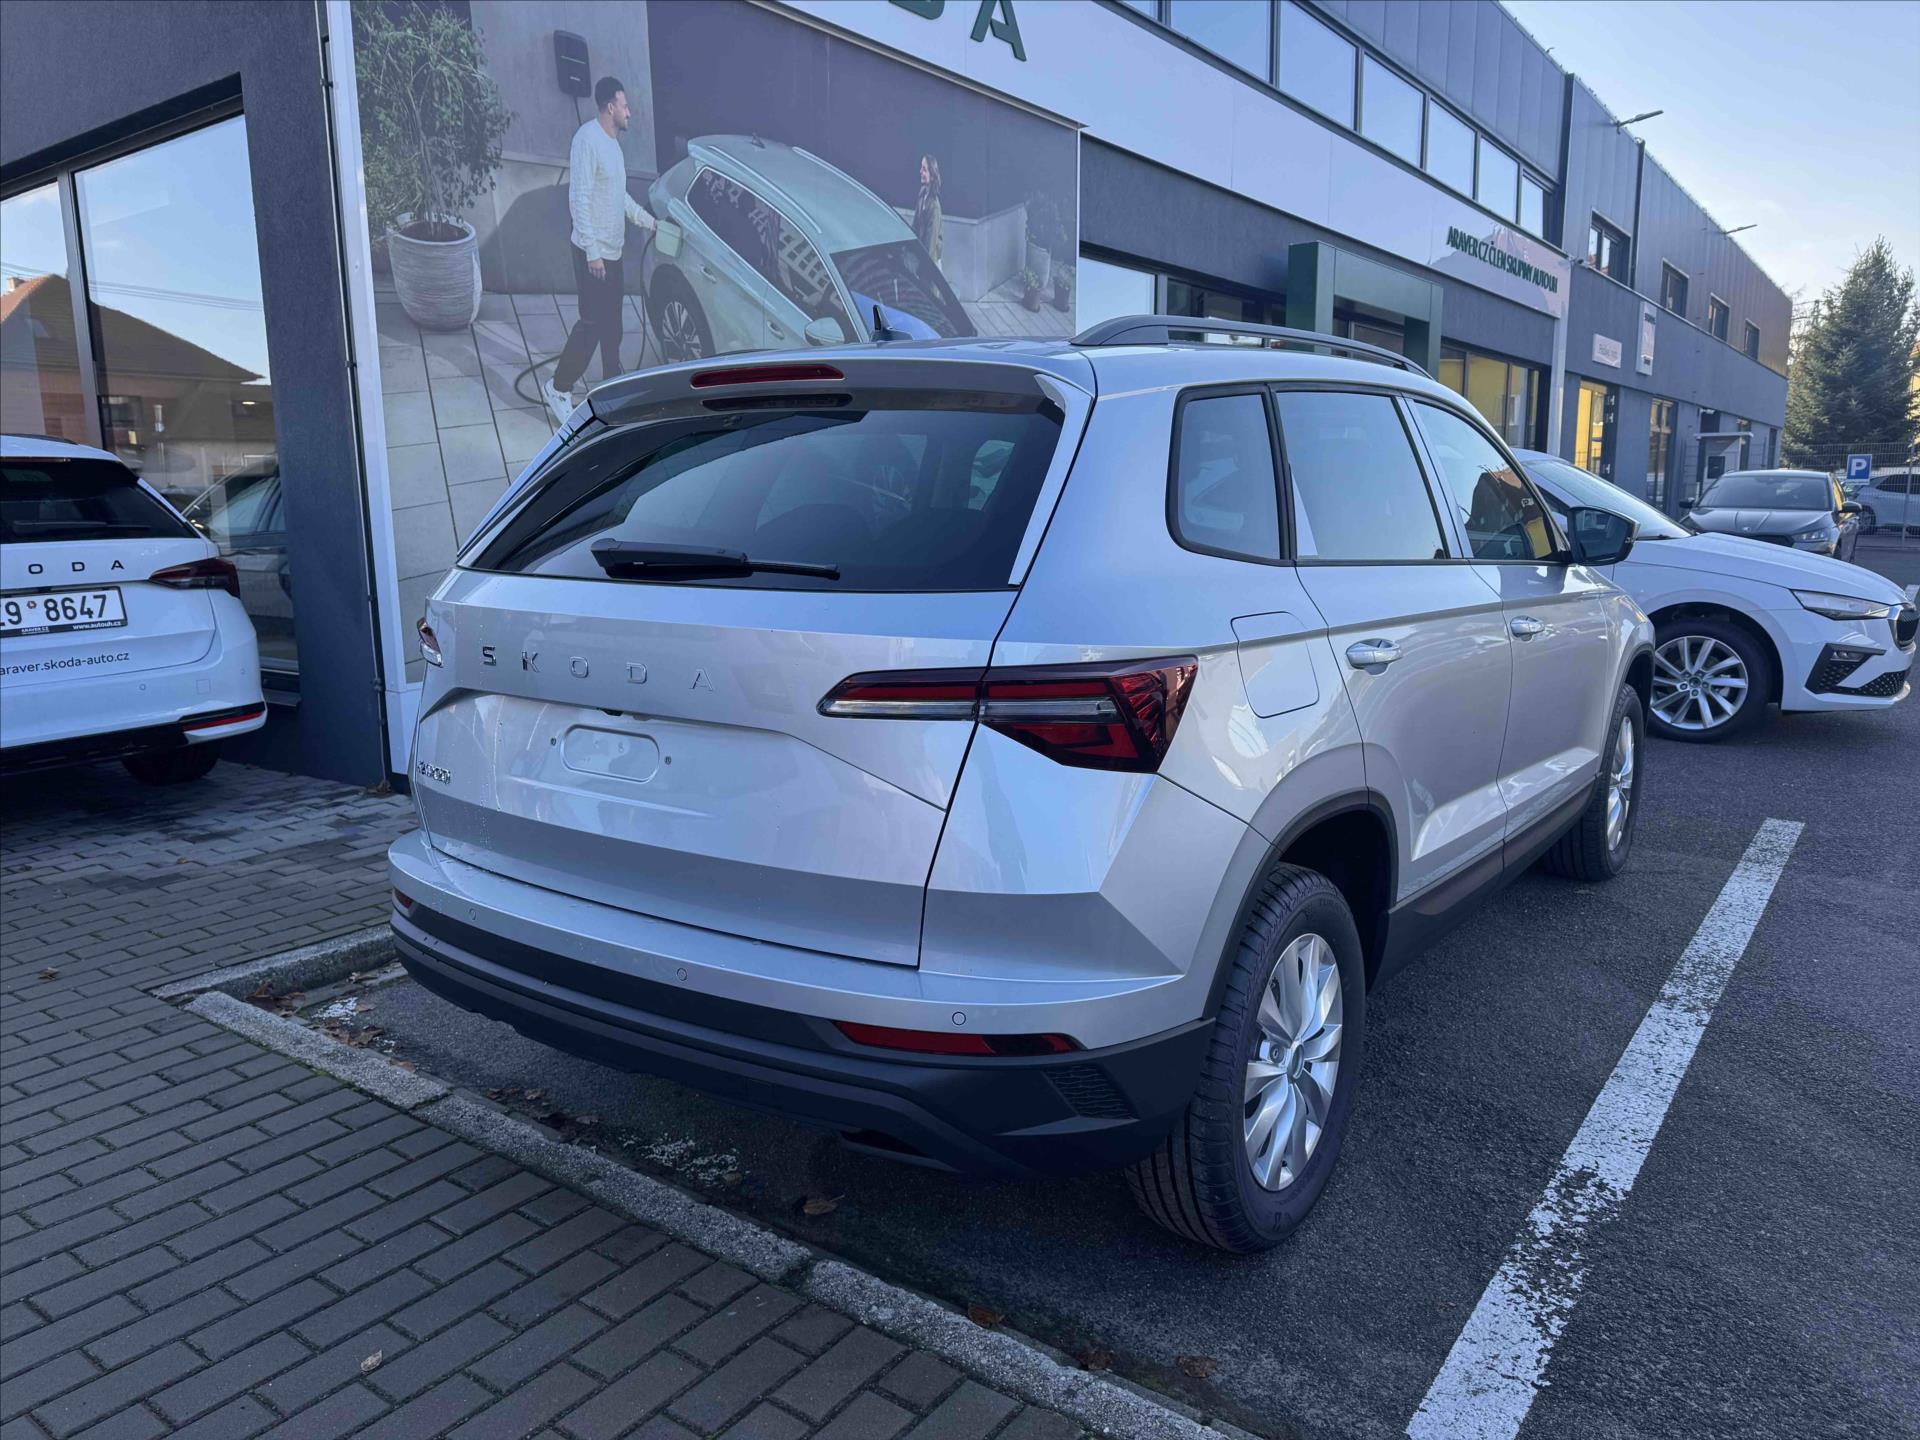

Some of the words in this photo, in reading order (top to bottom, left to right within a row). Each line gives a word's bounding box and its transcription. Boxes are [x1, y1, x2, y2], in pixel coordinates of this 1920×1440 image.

[1446, 226, 1478, 258] ARAVER
[1478, 241, 1489, 263] CZ
[1507, 254, 1533, 283] SKUPINY
[1851, 459, 1867, 476] P
[43, 594, 107, 622] 8647
[482, 646, 714, 692] SKODA
